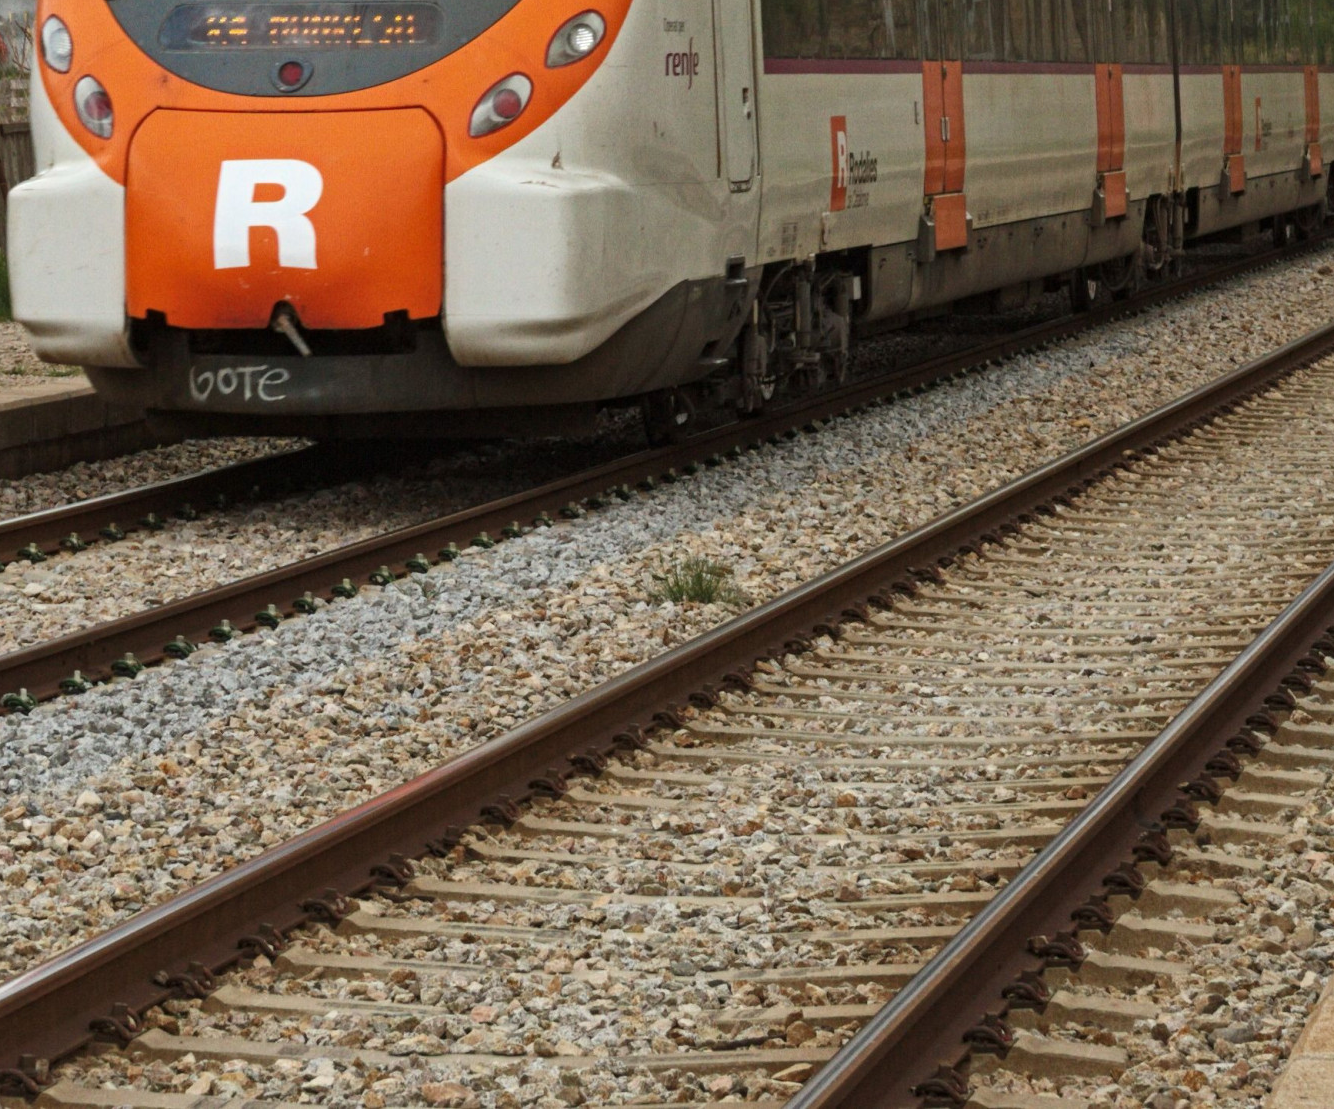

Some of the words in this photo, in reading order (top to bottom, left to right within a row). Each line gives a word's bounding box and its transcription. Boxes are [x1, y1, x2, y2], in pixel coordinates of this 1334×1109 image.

[665, 36, 699, 90] renfe
[849, 150, 878, 185] Rodalies
[213, 158, 324, 270] R
